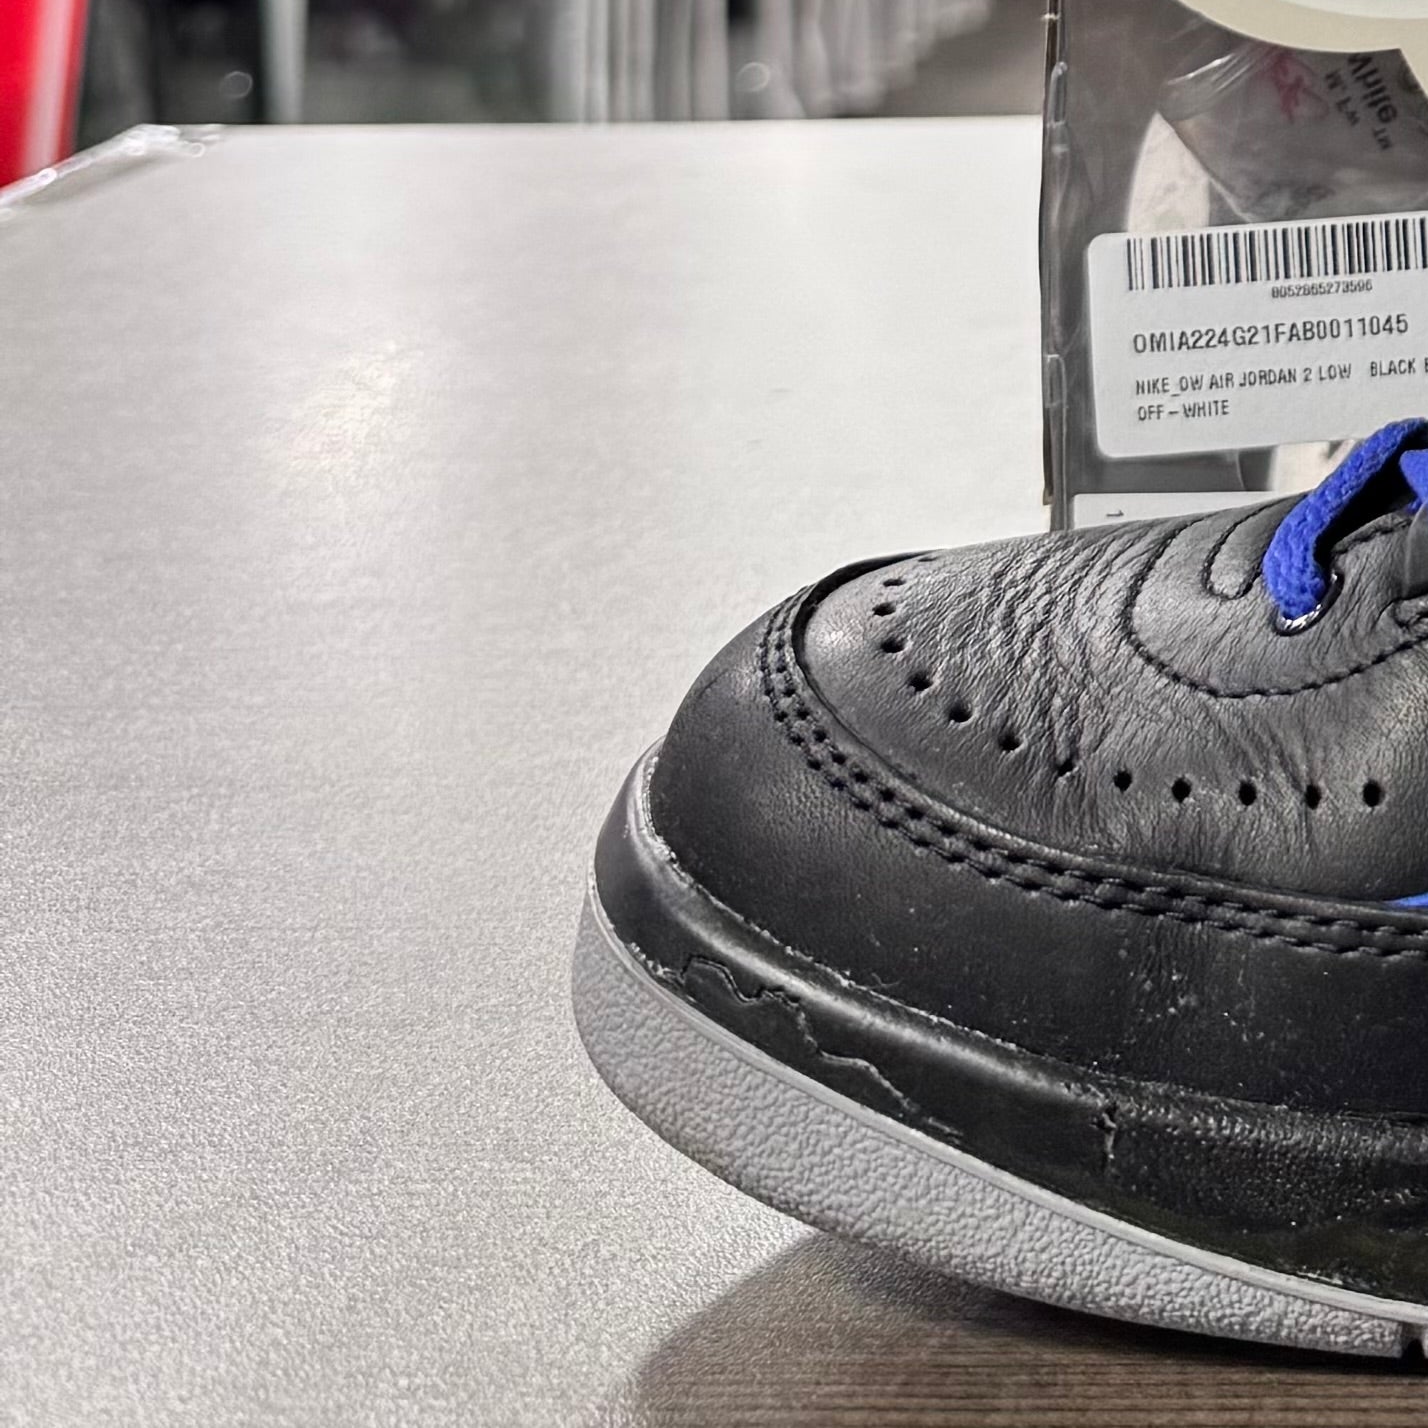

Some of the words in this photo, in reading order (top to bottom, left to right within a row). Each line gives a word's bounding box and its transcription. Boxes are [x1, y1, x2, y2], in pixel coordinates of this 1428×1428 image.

[1208, 372, 1235, 390] AIR
[1239, 367, 1297, 388] JORDAN
[1303, 367, 1313, 383] 2
[1318, 363, 1352, 382] LOW
[1370, 357, 1417, 378] BLACK
